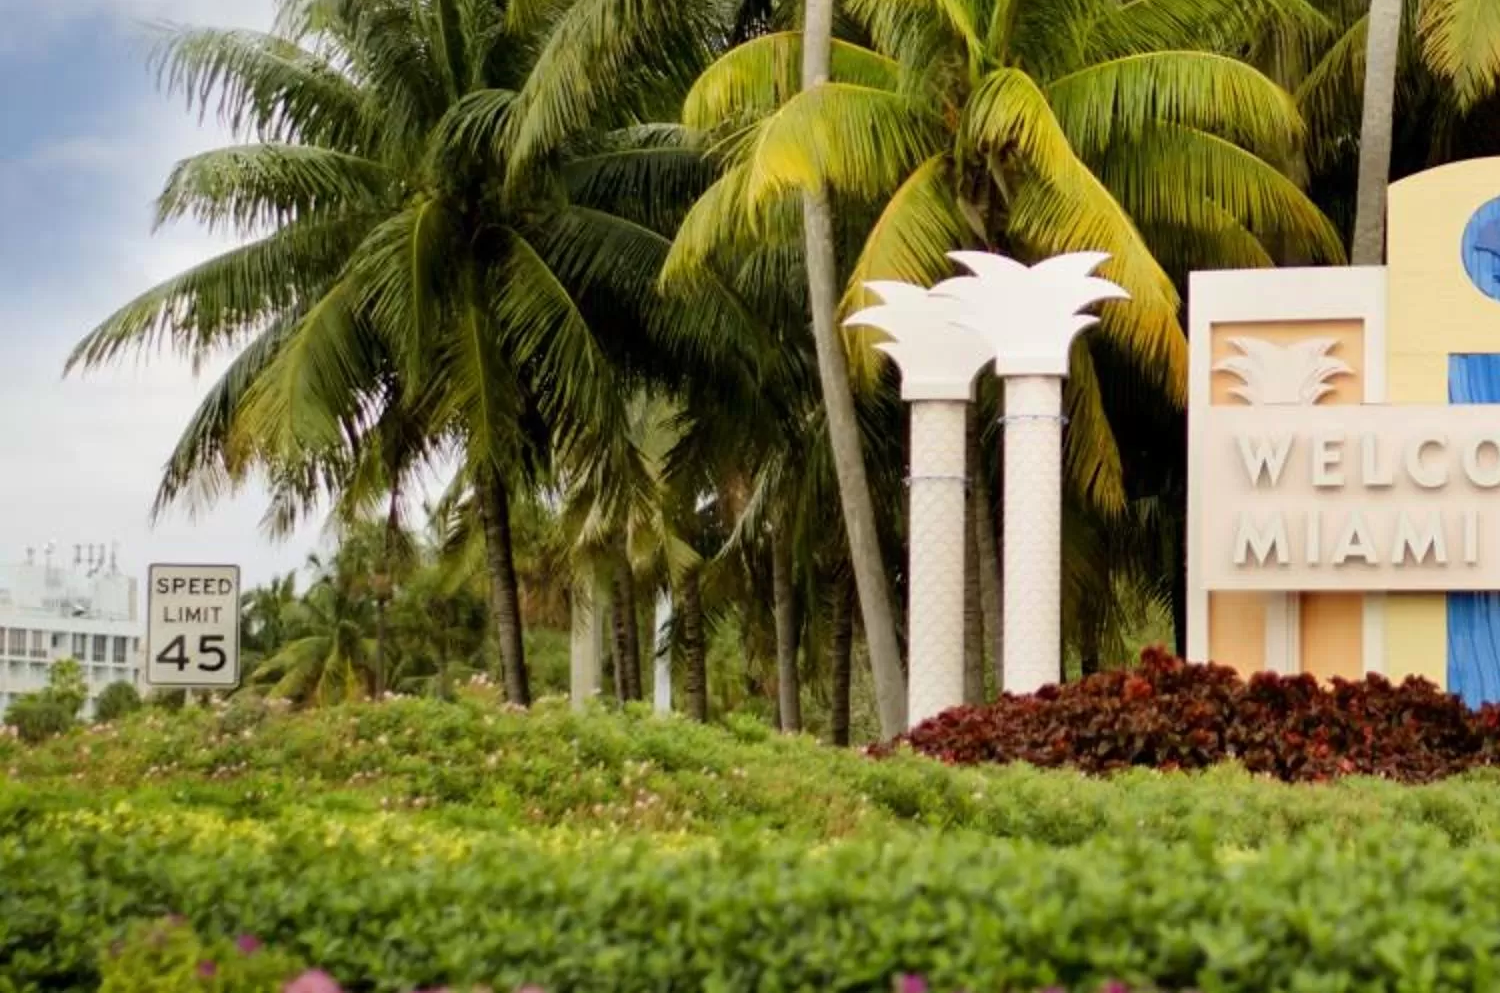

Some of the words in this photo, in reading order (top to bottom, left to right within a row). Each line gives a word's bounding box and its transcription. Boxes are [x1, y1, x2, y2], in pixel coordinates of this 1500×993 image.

[1232, 507, 1480, 568] MIAMI
[156, 577, 233, 595] SPEED
[163, 606, 223, 623] LIMIT
[156, 634, 228, 672] 45
